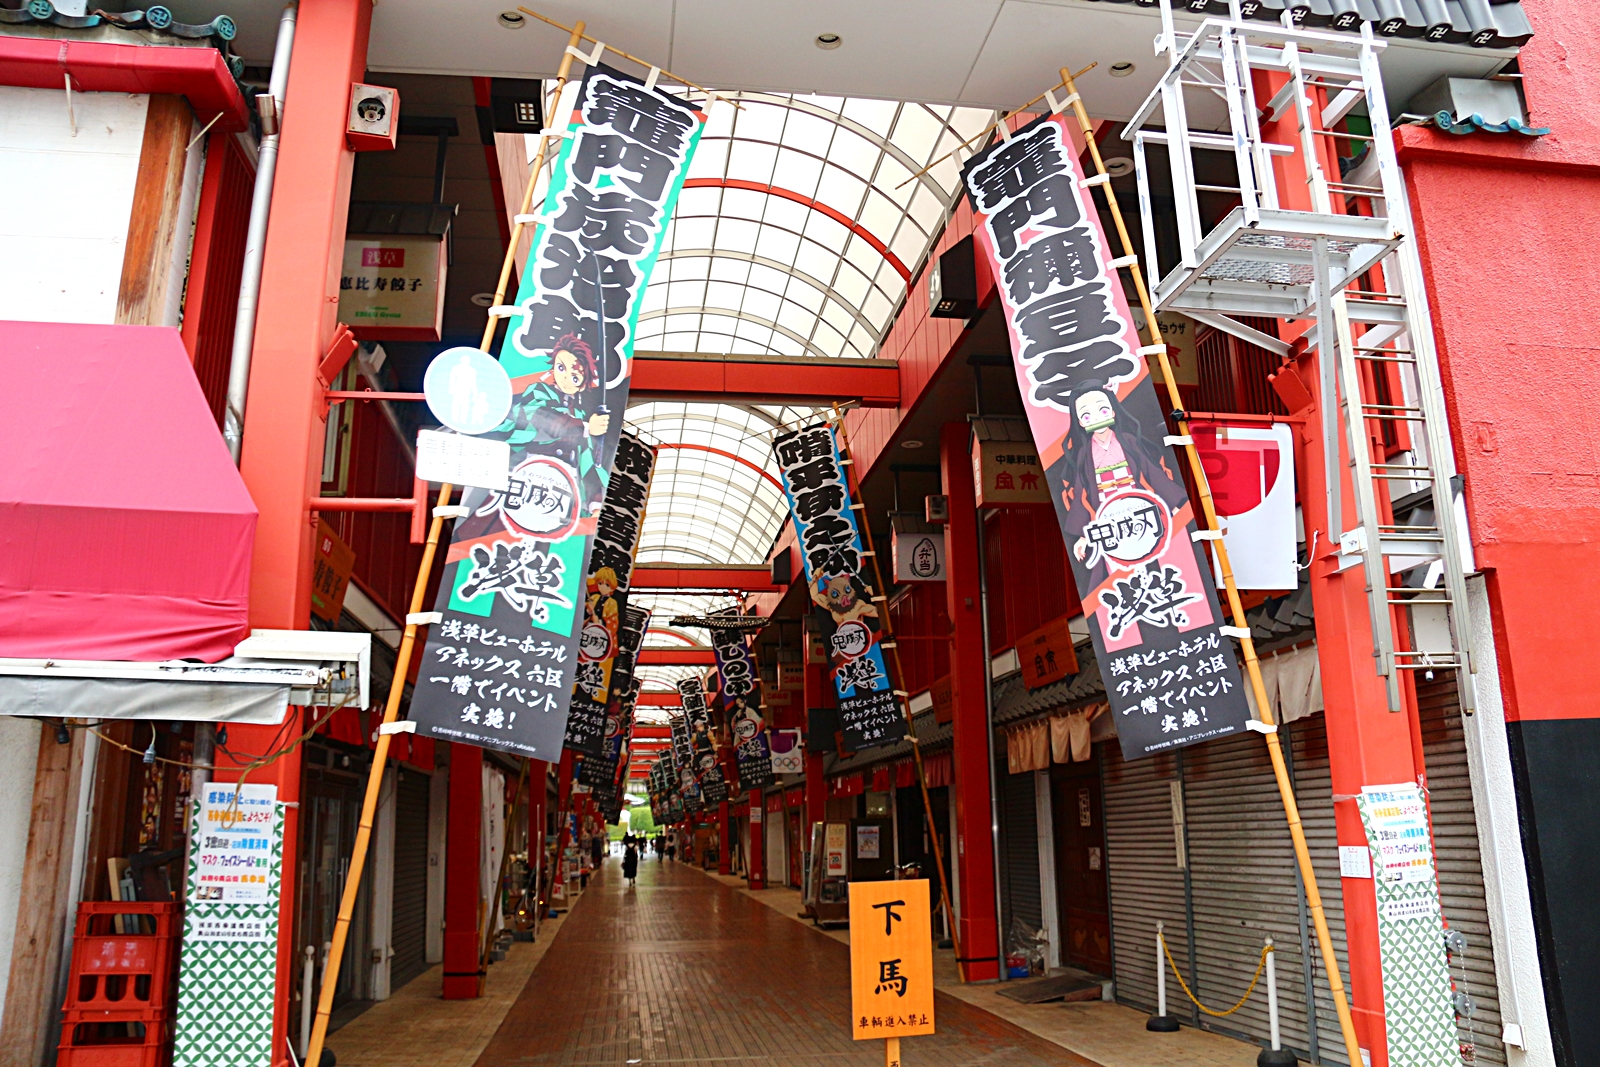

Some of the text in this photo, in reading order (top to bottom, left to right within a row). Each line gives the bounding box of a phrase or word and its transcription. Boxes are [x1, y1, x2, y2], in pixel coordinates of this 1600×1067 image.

[368, 251, 396, 265] 浅草
[340, 276, 422, 291] 恵比寿餃子
[996, 455, 1037, 466] 中華料理
[1087, 505, 1162, 565] 鬼滅の刃
[918, 547, 931, 571] 弁当
[460, 542, 573, 622] 浅草
[1101, 567, 1200, 637] 浅草
[441, 619, 568, 663] 浅草ビューホテル
[1110, 632, 1220, 676] 浅草ビューホテル
[436, 646, 563, 689] アネックス 六区
[838, 658, 885, 693] 浅草
[1116, 654, 1228, 698] アネックス 六区
[429, 675, 558, 713] 一階でイベント
[841, 693, 893, 712] 浅草ビューホテル
[1122, 676, 1233, 716] 一階でイベント
[461, 705, 518, 731] 実施!
[1161, 706, 1208, 733] 実施!
[872, 900, 908, 998] 下馬
